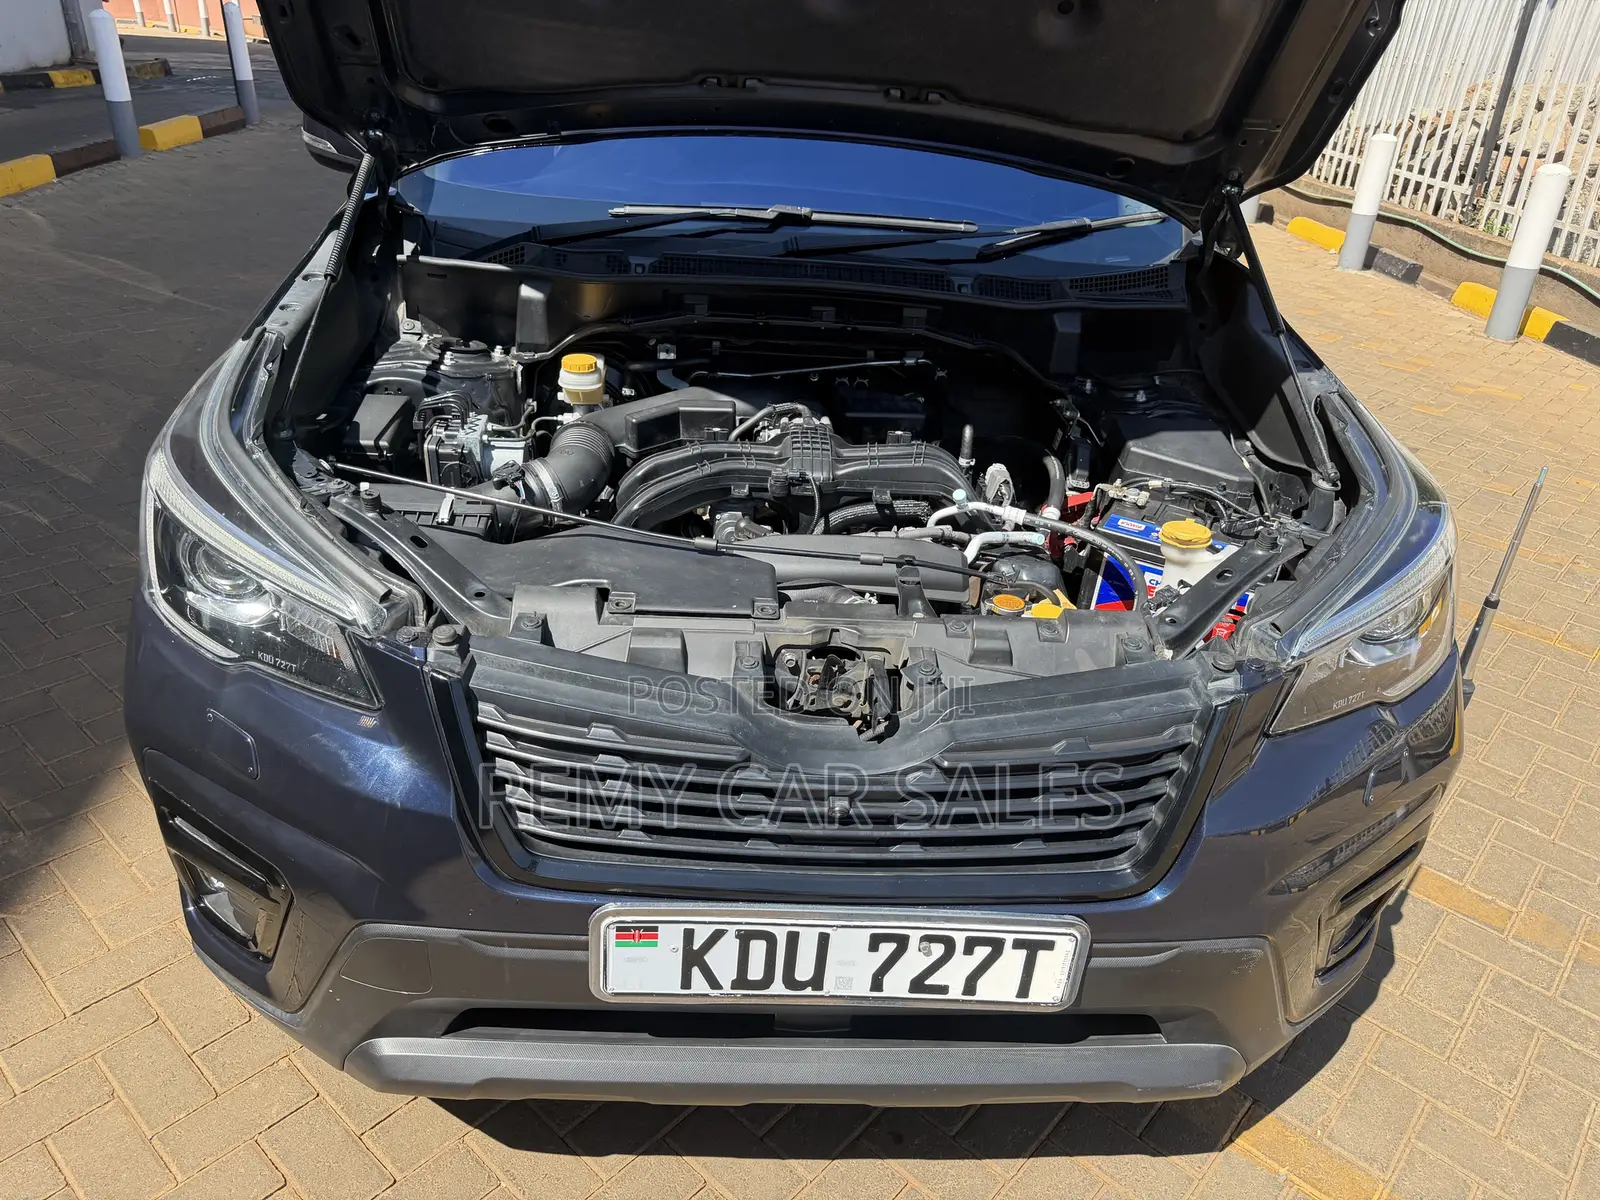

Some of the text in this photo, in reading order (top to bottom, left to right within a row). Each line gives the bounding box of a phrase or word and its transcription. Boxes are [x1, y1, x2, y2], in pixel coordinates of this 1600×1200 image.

[257, 651, 297, 672] KDU 727T
[1332, 690, 1366, 710] KDU 727T
[679, 927, 831, 993] KDU
[867, 932, 1056, 999] 727T
